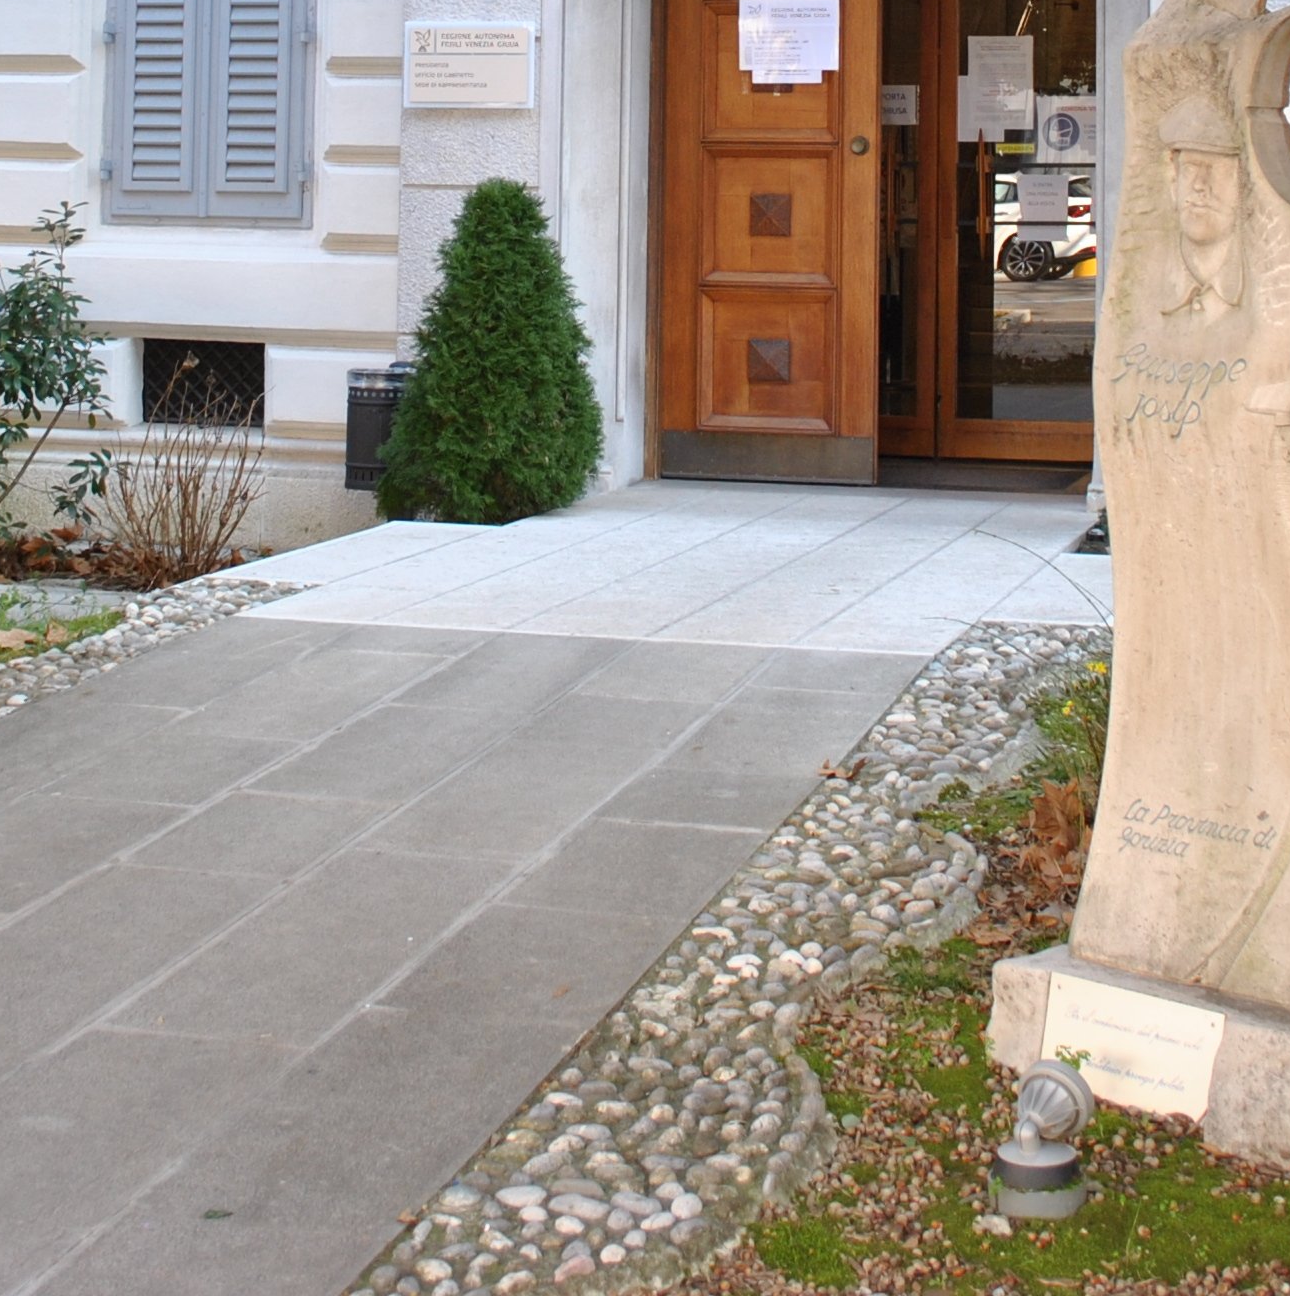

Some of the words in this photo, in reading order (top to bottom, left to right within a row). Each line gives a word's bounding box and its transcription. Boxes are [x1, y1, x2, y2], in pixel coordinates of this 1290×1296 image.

[1111, 343, 1247, 400] Giuseppe
[1118, 826, 1190, 857] Gorizia
[1123, 798, 1150, 822] La
[1149, 804, 1250, 845] Provincia
